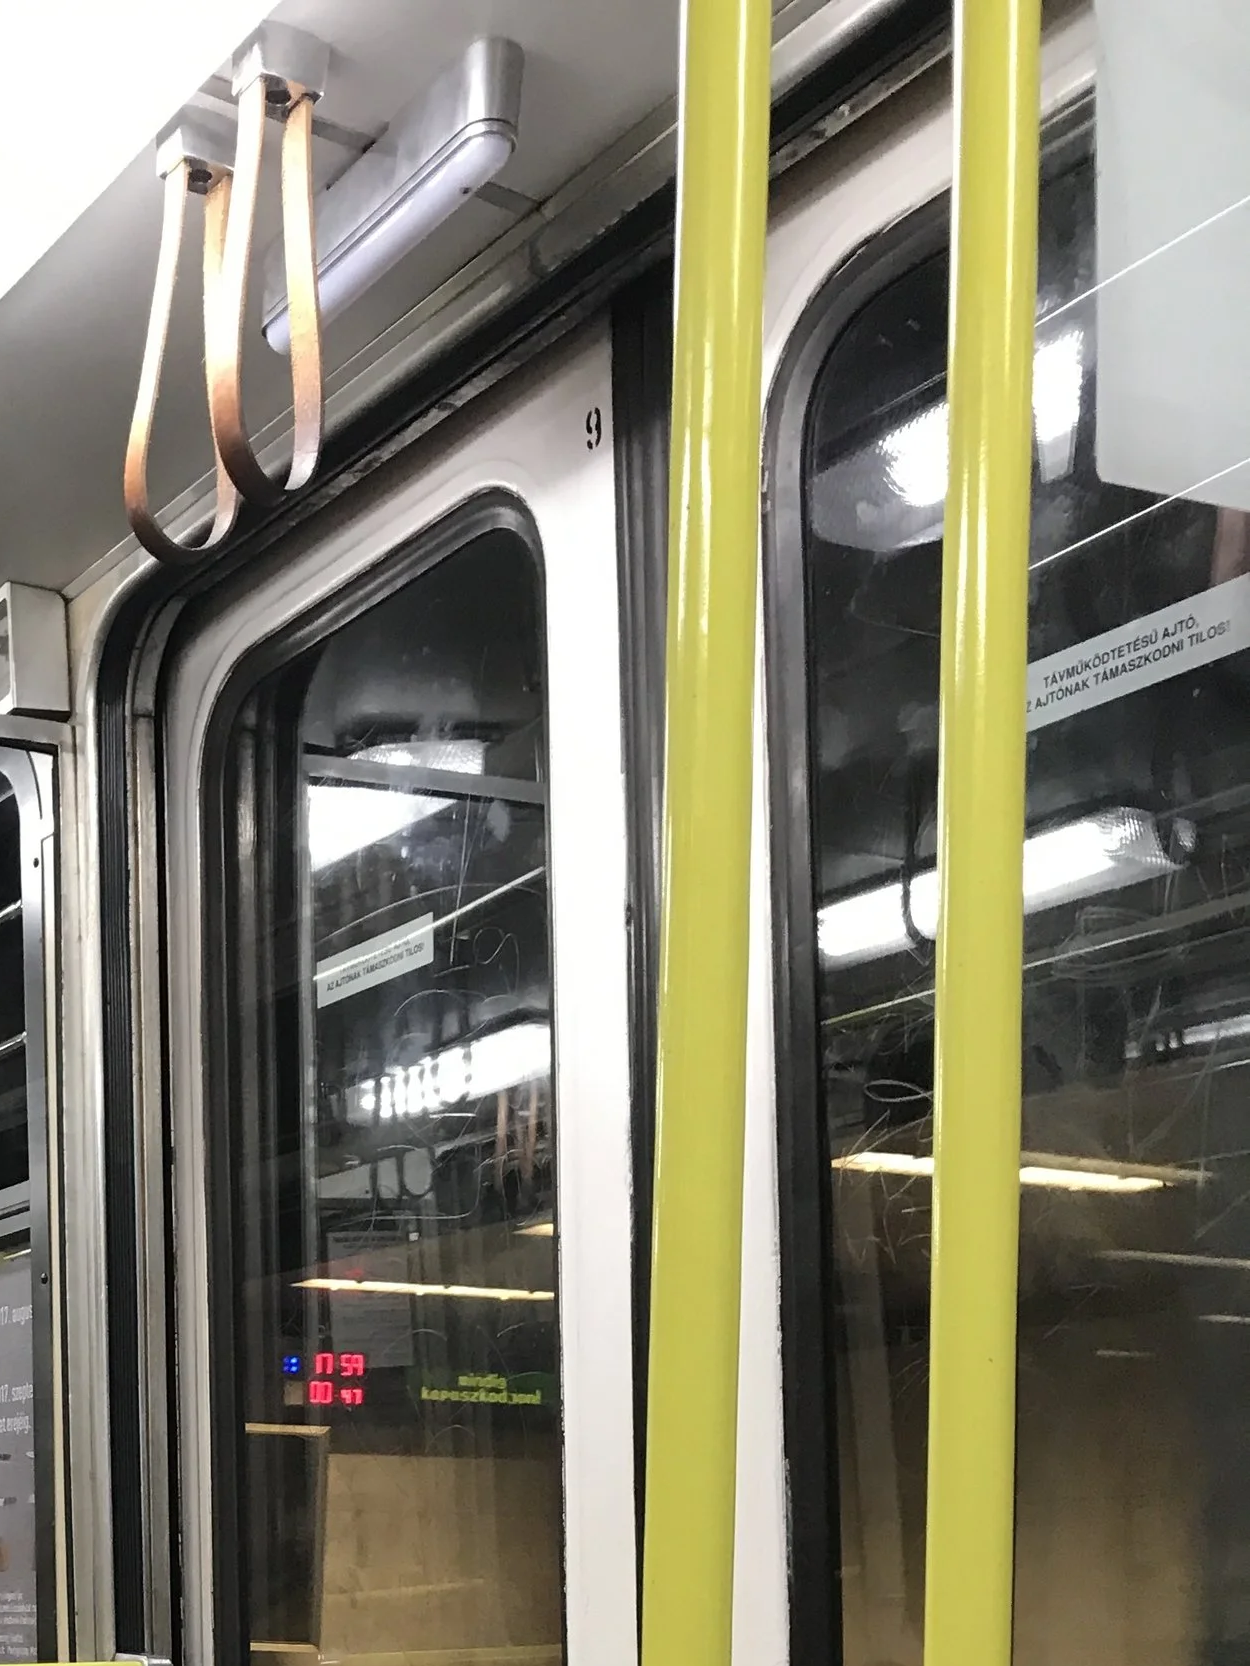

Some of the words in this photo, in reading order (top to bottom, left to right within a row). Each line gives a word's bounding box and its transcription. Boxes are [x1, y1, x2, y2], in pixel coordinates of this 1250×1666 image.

[586, 407, 602, 450] 9
[1034, 679, 1091, 710] AJTÓNAK
[1093, 639, 1186, 687] TÁMASZKODNI
